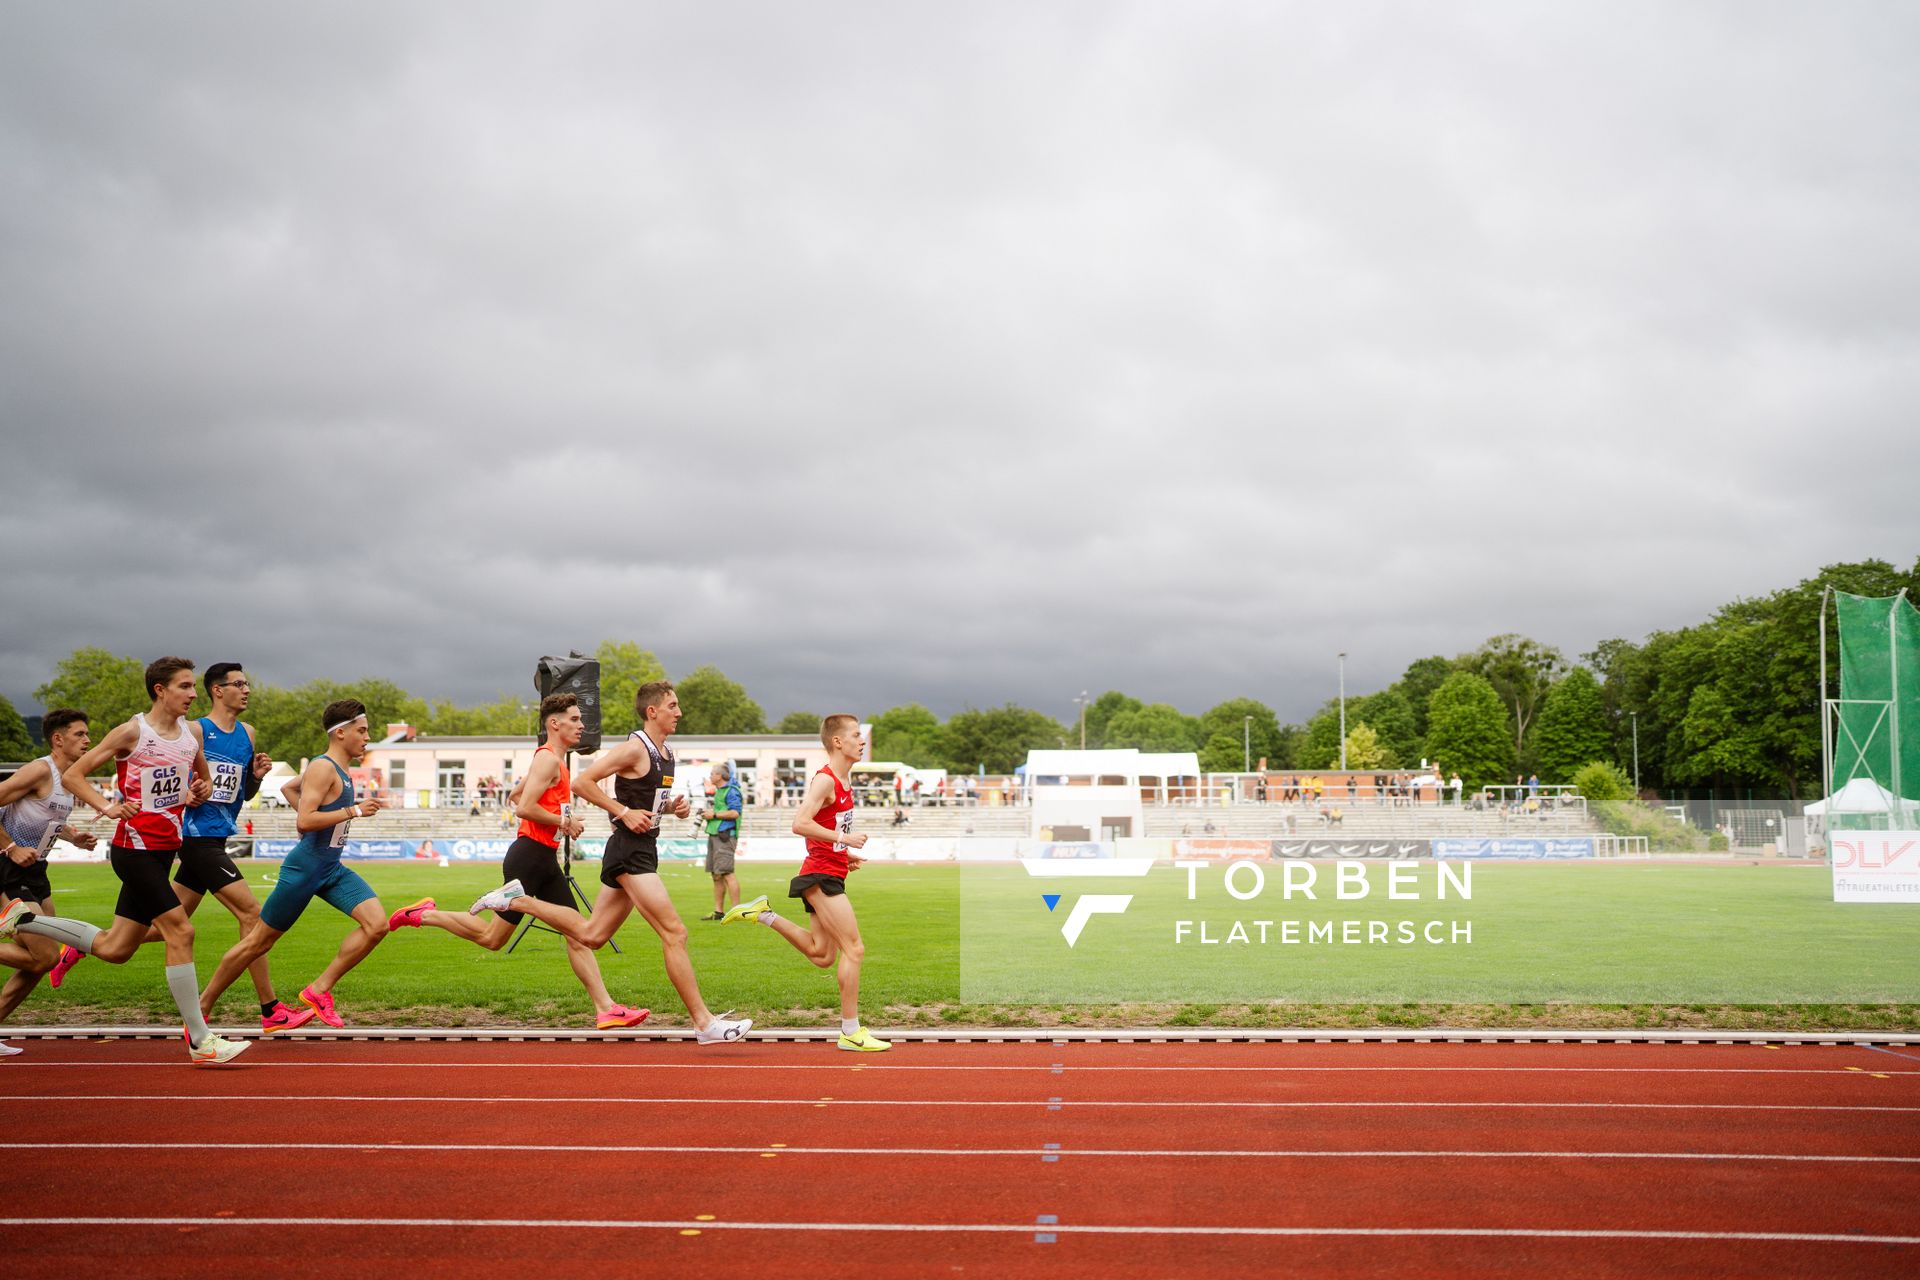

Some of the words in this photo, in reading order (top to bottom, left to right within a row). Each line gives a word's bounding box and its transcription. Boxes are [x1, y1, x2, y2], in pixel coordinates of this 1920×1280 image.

[152, 766, 177, 779] GLS
[216, 764, 236, 775] GLS
[151, 777, 181, 796] 442
[213, 774, 238, 791] 443
[1834, 841, 1916, 867] DLV
